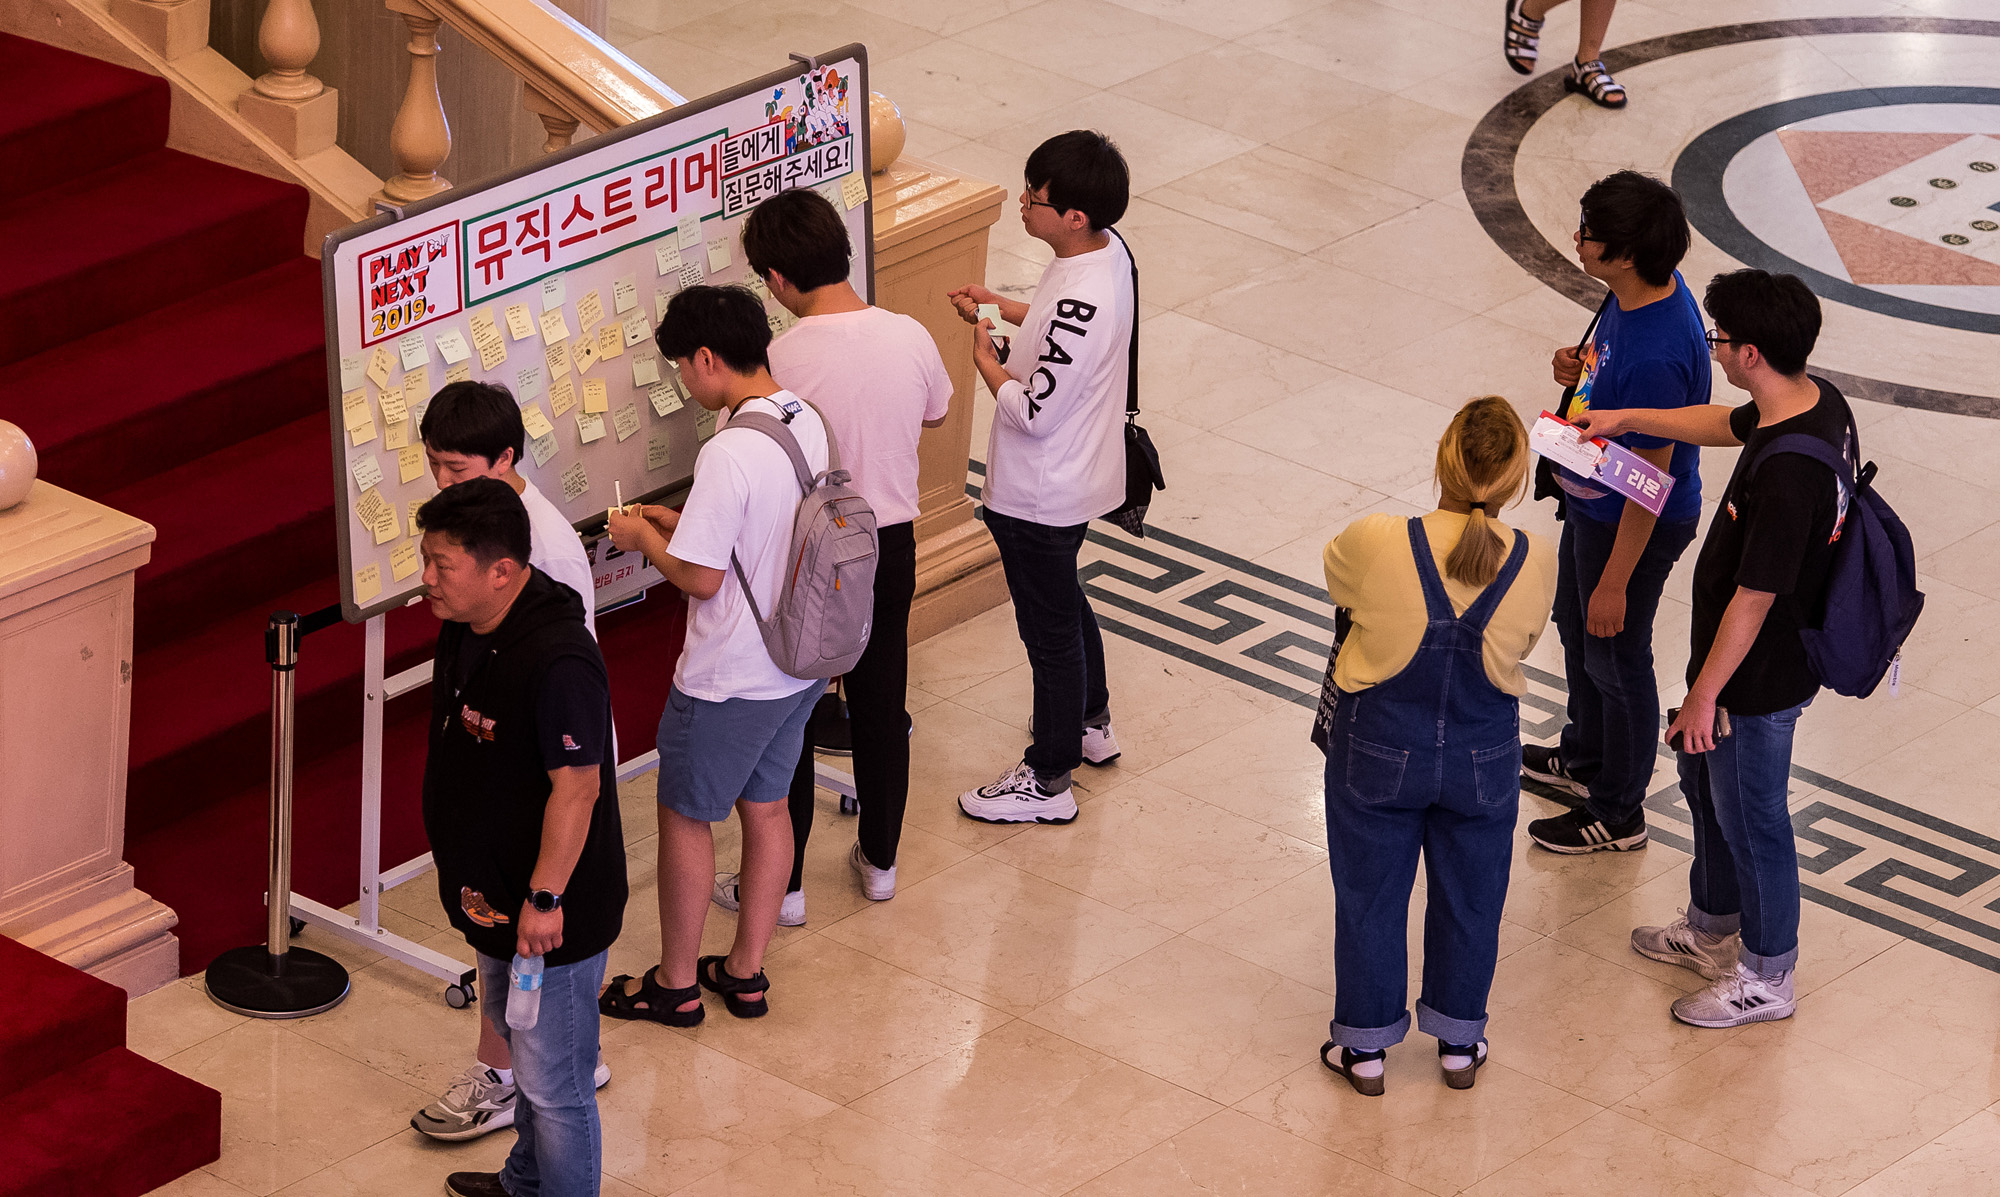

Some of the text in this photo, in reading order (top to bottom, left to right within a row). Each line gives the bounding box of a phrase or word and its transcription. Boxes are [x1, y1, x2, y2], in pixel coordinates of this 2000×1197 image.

[722, 125, 780, 173] 들에게
[475, 144, 717, 285] 뮤직스트리머
[370, 242, 425, 284] PLAY
[371, 265, 429, 310] NEXT
[372, 295, 426, 337] 2019
[1023, 299, 1097, 420] BLACK
[1614, 460, 1661, 500] 1 라온
[616, 565, 634, 581] 금지
